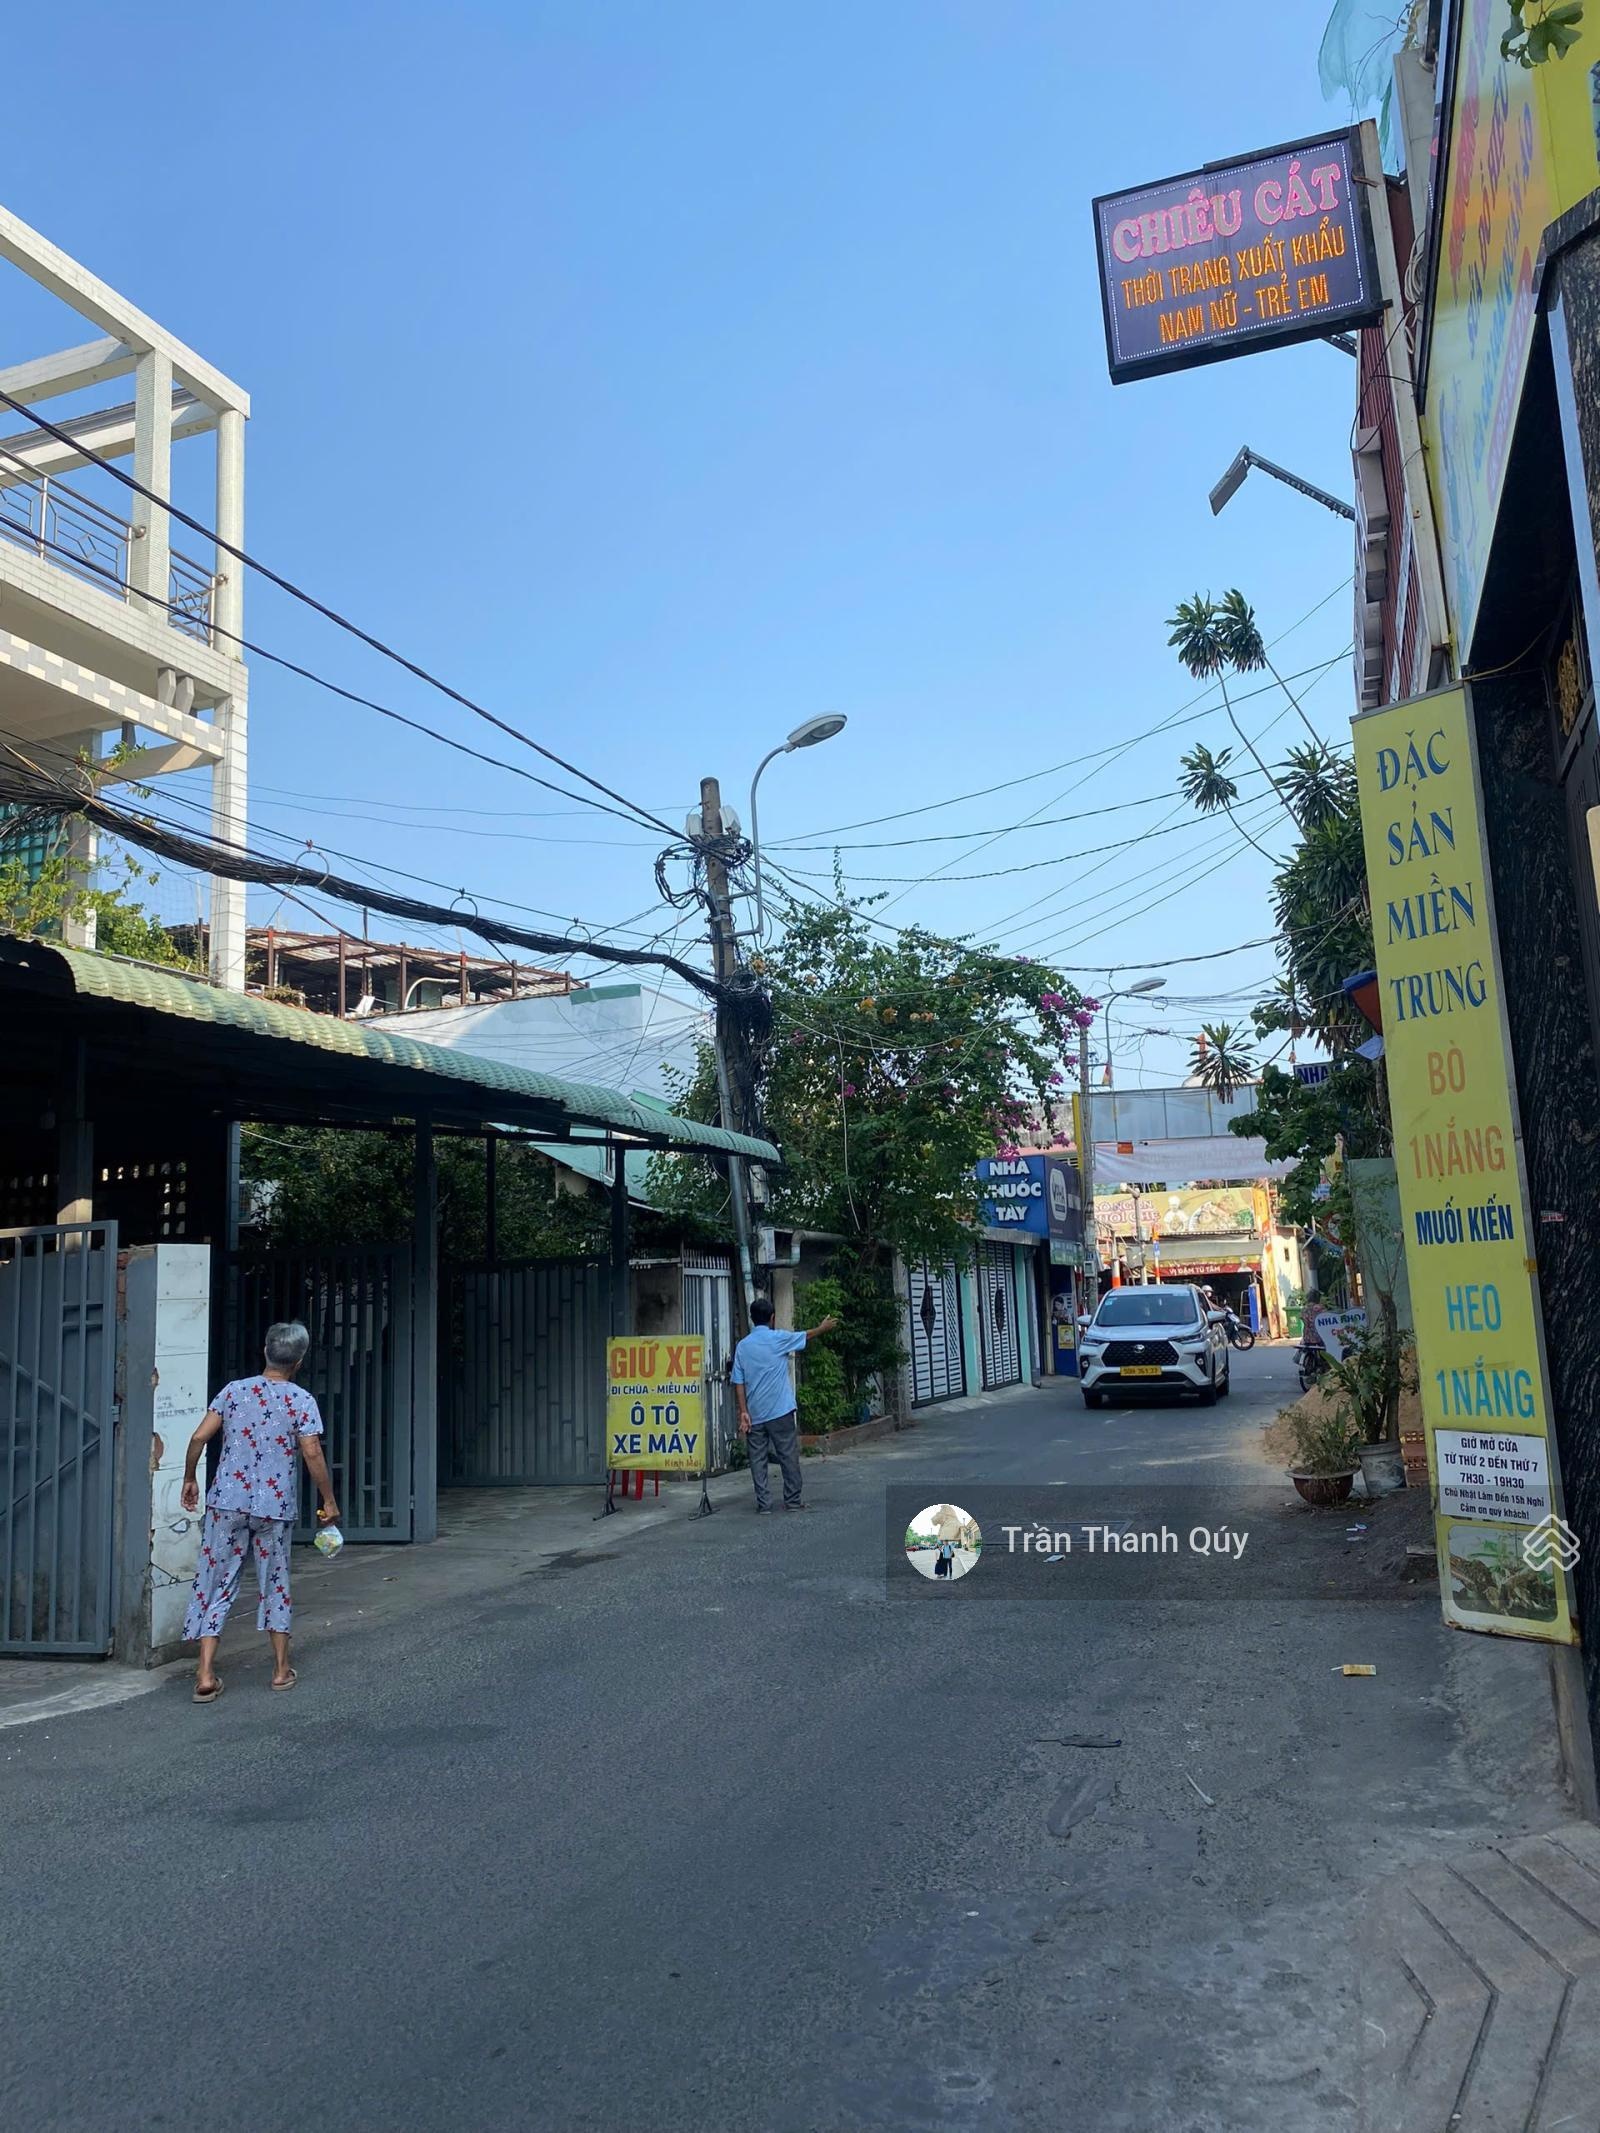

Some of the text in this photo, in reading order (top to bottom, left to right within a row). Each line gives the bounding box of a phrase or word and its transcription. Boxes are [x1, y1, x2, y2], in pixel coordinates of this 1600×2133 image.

[1113, 161, 1341, 263] CHIÊU CÁT
[1122, 216, 1345, 309] THỜI TRANG XUẤT KHẨU
[1160, 305, 1205, 343] NAM
[1210, 291, 1237, 331] NỮ
[1256, 273, 1292, 319] TRẺ
[1297, 274, 1329, 310] EM
[1376, 728, 1450, 792] ĐẶC
[1388, 801, 1455, 866] SẢN
[1387, 872, 1475, 944] MIỀN
[1390, 961, 1487, 1021] TRUNG
[1428, 1040, 1465, 1095] BÒ
[989, 1158, 1030, 1176] NHÀ
[1415, 1194, 1514, 1245] MUỐI KIẾN
[1445, 1284, 1500, 1332] HEO
[611, 1341, 701, 1378] GIỮ XE
[631, 1401, 680, 1425] Ô TÔ
[614, 1429, 698, 1454] XE MÁY
[1459, 1453, 1477, 1466] THỨ
[1480, 1457, 1485, 1466] 2
[1488, 1455, 1507, 1470] ĐẾN
[1510, 1458, 1530, 1472] THỨ
[1531, 1462, 1538, 1472] 7
[1498, 1438, 1518, 1453] CỬA
[1460, 1472, 1484, 1485] 7H30
[1494, 1476, 1524, 1489] 19H30
[1511, 1495, 1525, 1504] 15h
